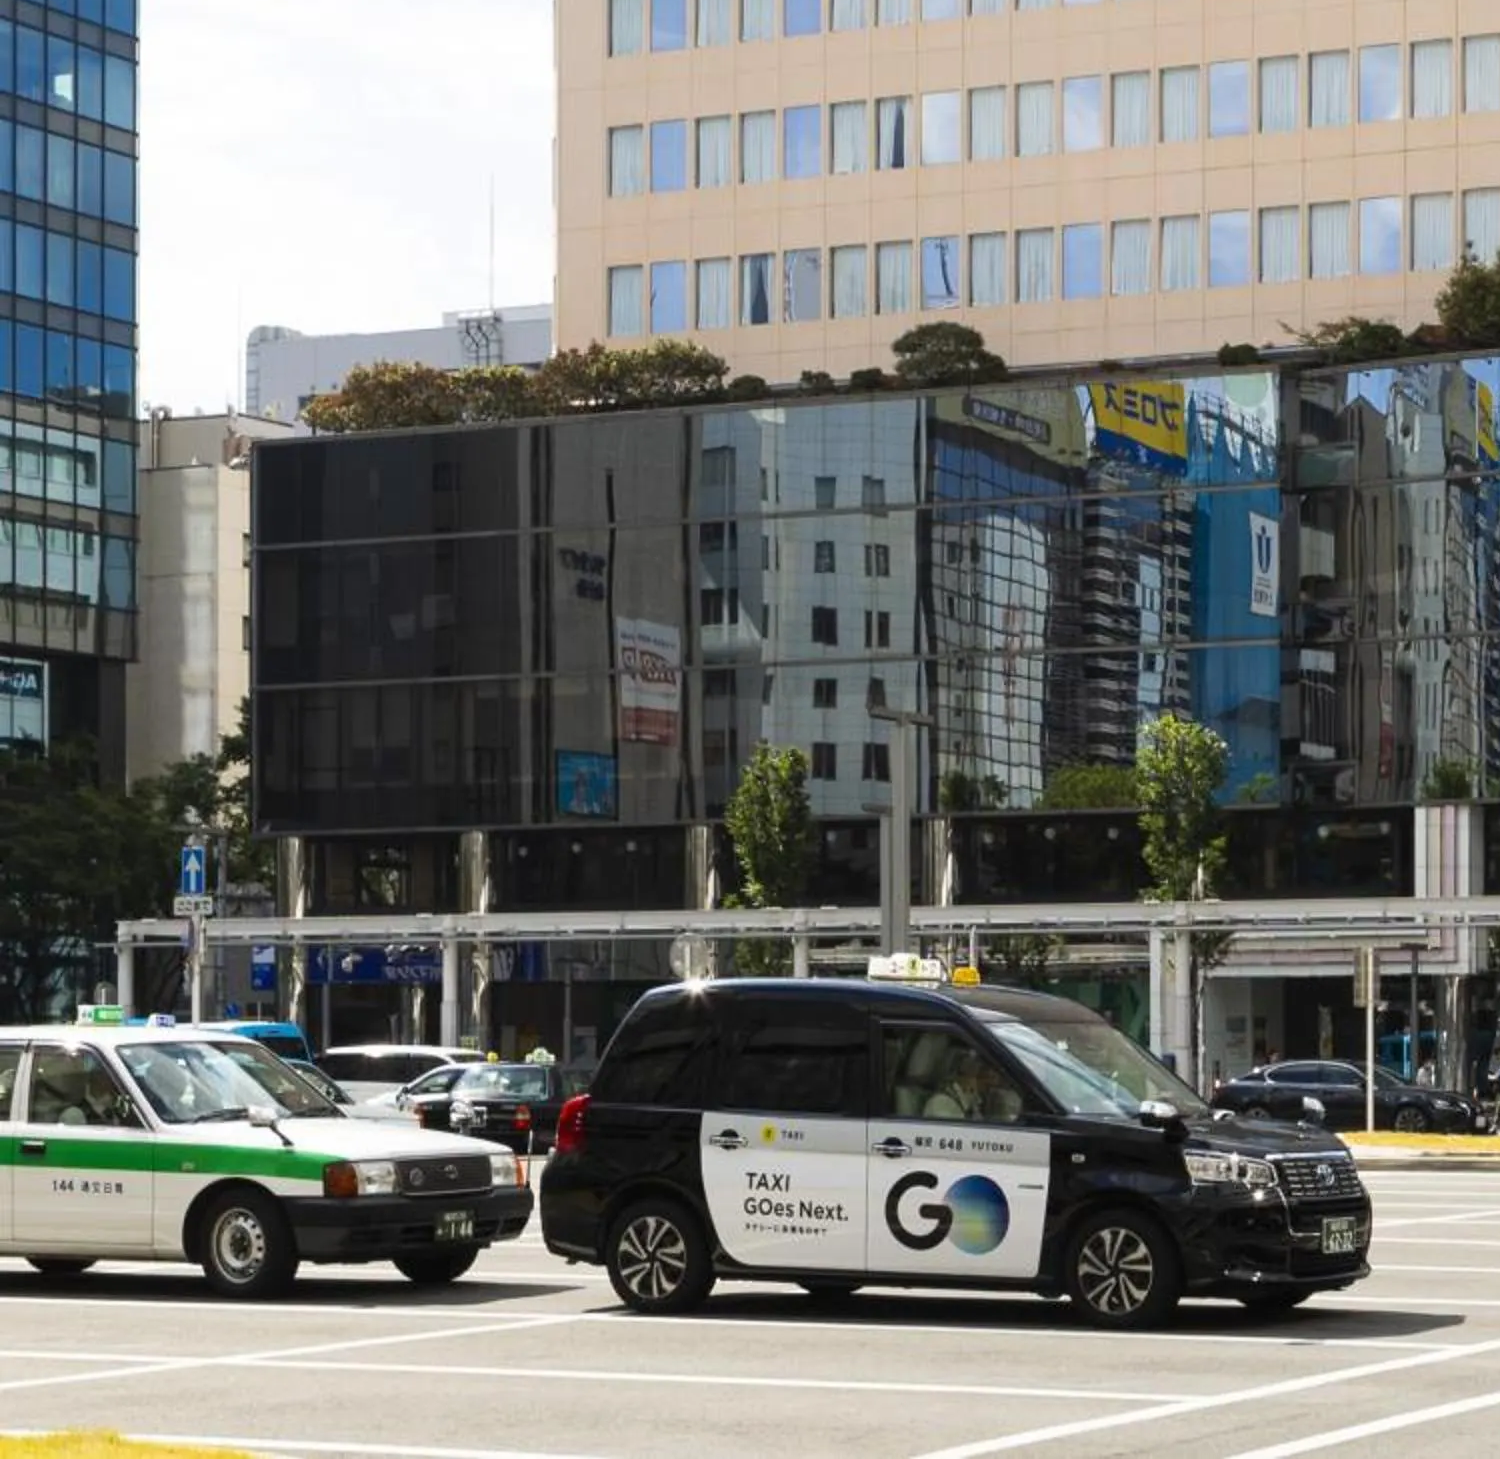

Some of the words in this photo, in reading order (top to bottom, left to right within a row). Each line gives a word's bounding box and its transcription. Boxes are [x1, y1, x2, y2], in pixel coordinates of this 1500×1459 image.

[780, 1130, 804, 1140] TAXI
[939, 1138, 962, 1151] 648
[971, 1141, 1014, 1152] YUTOKU
[52, 1180, 74, 1191] 144
[745, 1172, 791, 1192] TAXI
[744, 1197, 795, 1217] GOes
[799, 1199, 849, 1221] Next.
[885, 1170, 1010, 1255] GO
